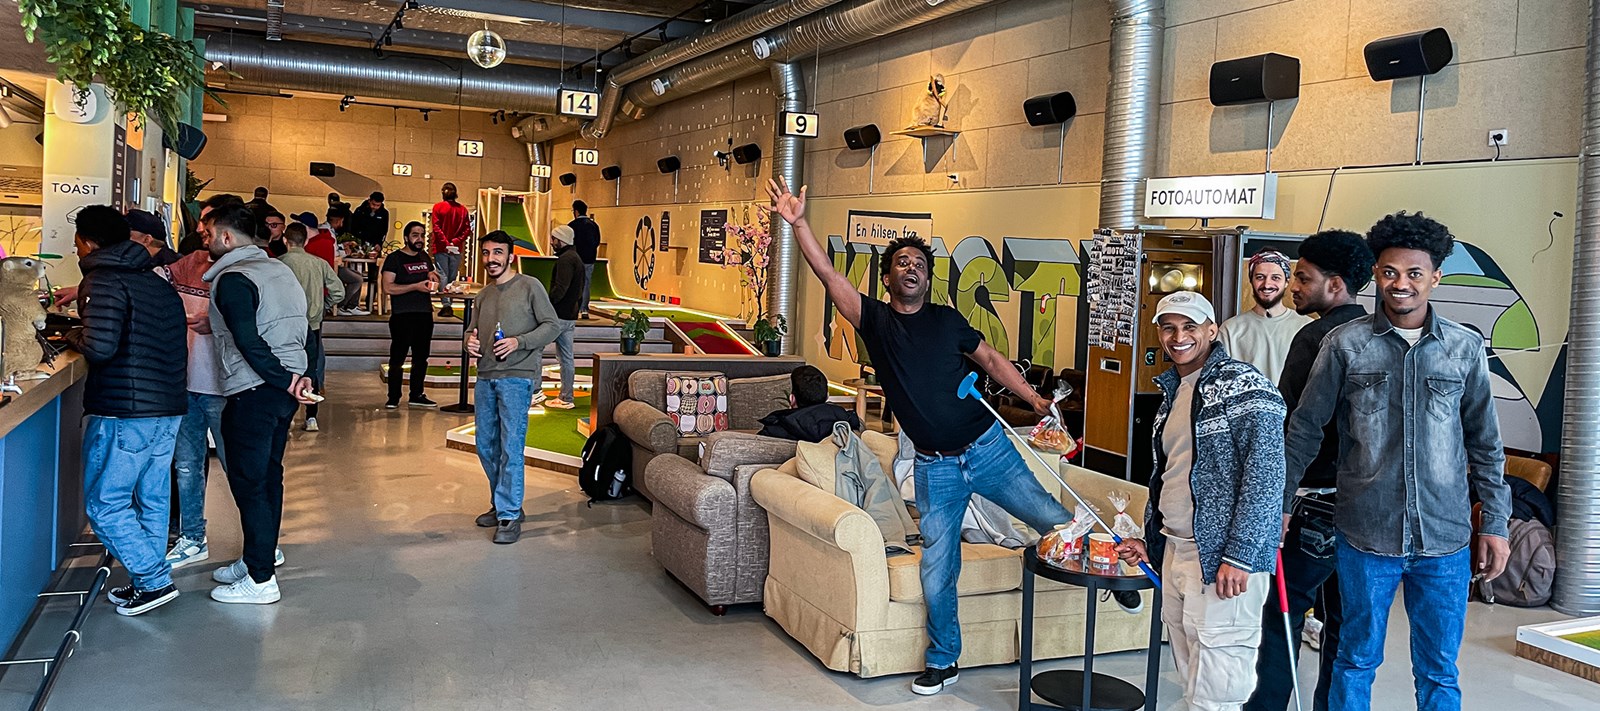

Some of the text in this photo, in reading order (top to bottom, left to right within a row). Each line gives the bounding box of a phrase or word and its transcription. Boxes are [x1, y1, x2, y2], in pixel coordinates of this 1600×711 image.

[567, 93, 592, 113] 14
[796, 115, 807, 133] 9
[463, 142, 478, 154] 13
[579, 151, 594, 163] 10
[397, 165, 409, 174] 12
[536, 166, 546, 176] 11
[51, 182, 99, 195] TOAST
[1150, 188, 1257, 206] FOTOAUTOMAT
[856, 223, 867, 238] En
[871, 223, 897, 240] hilsen
